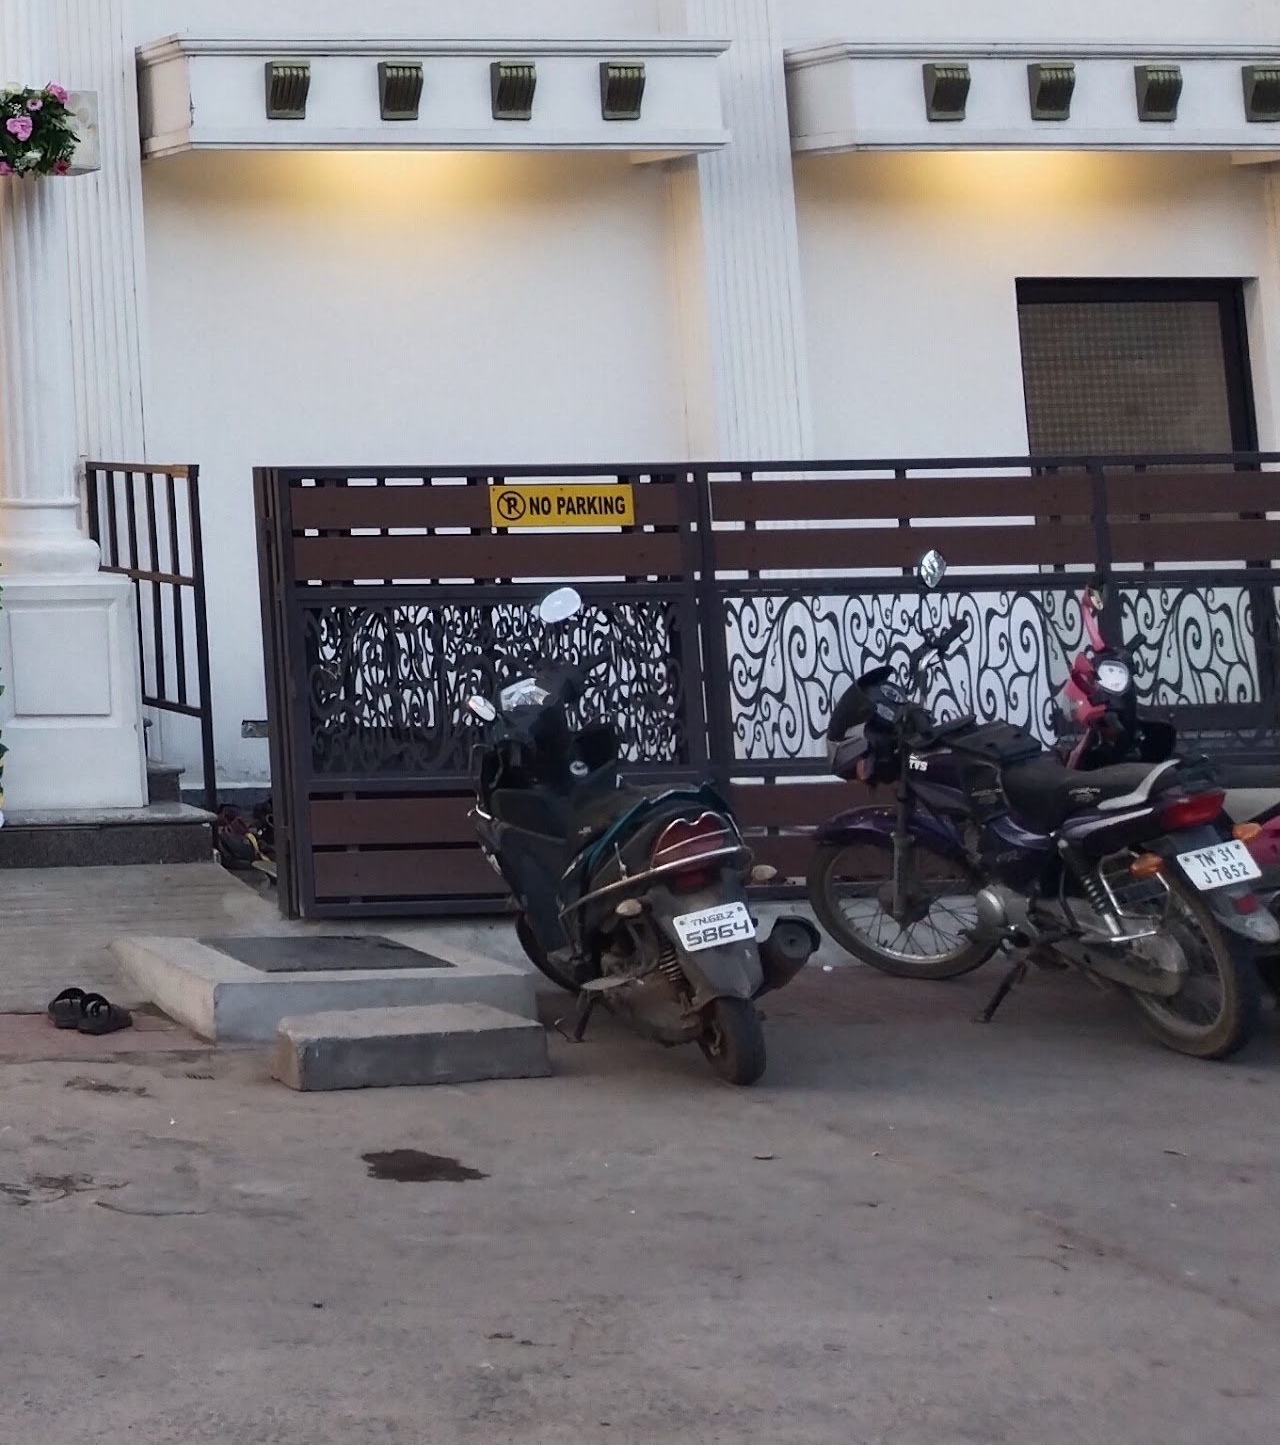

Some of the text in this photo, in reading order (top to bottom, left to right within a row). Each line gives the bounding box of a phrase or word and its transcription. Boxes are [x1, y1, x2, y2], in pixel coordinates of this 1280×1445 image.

[530, 496, 625, 515] NO PARKING
[1194, 847, 1236, 867] TN 31
[685, 920, 750, 947] 5864
